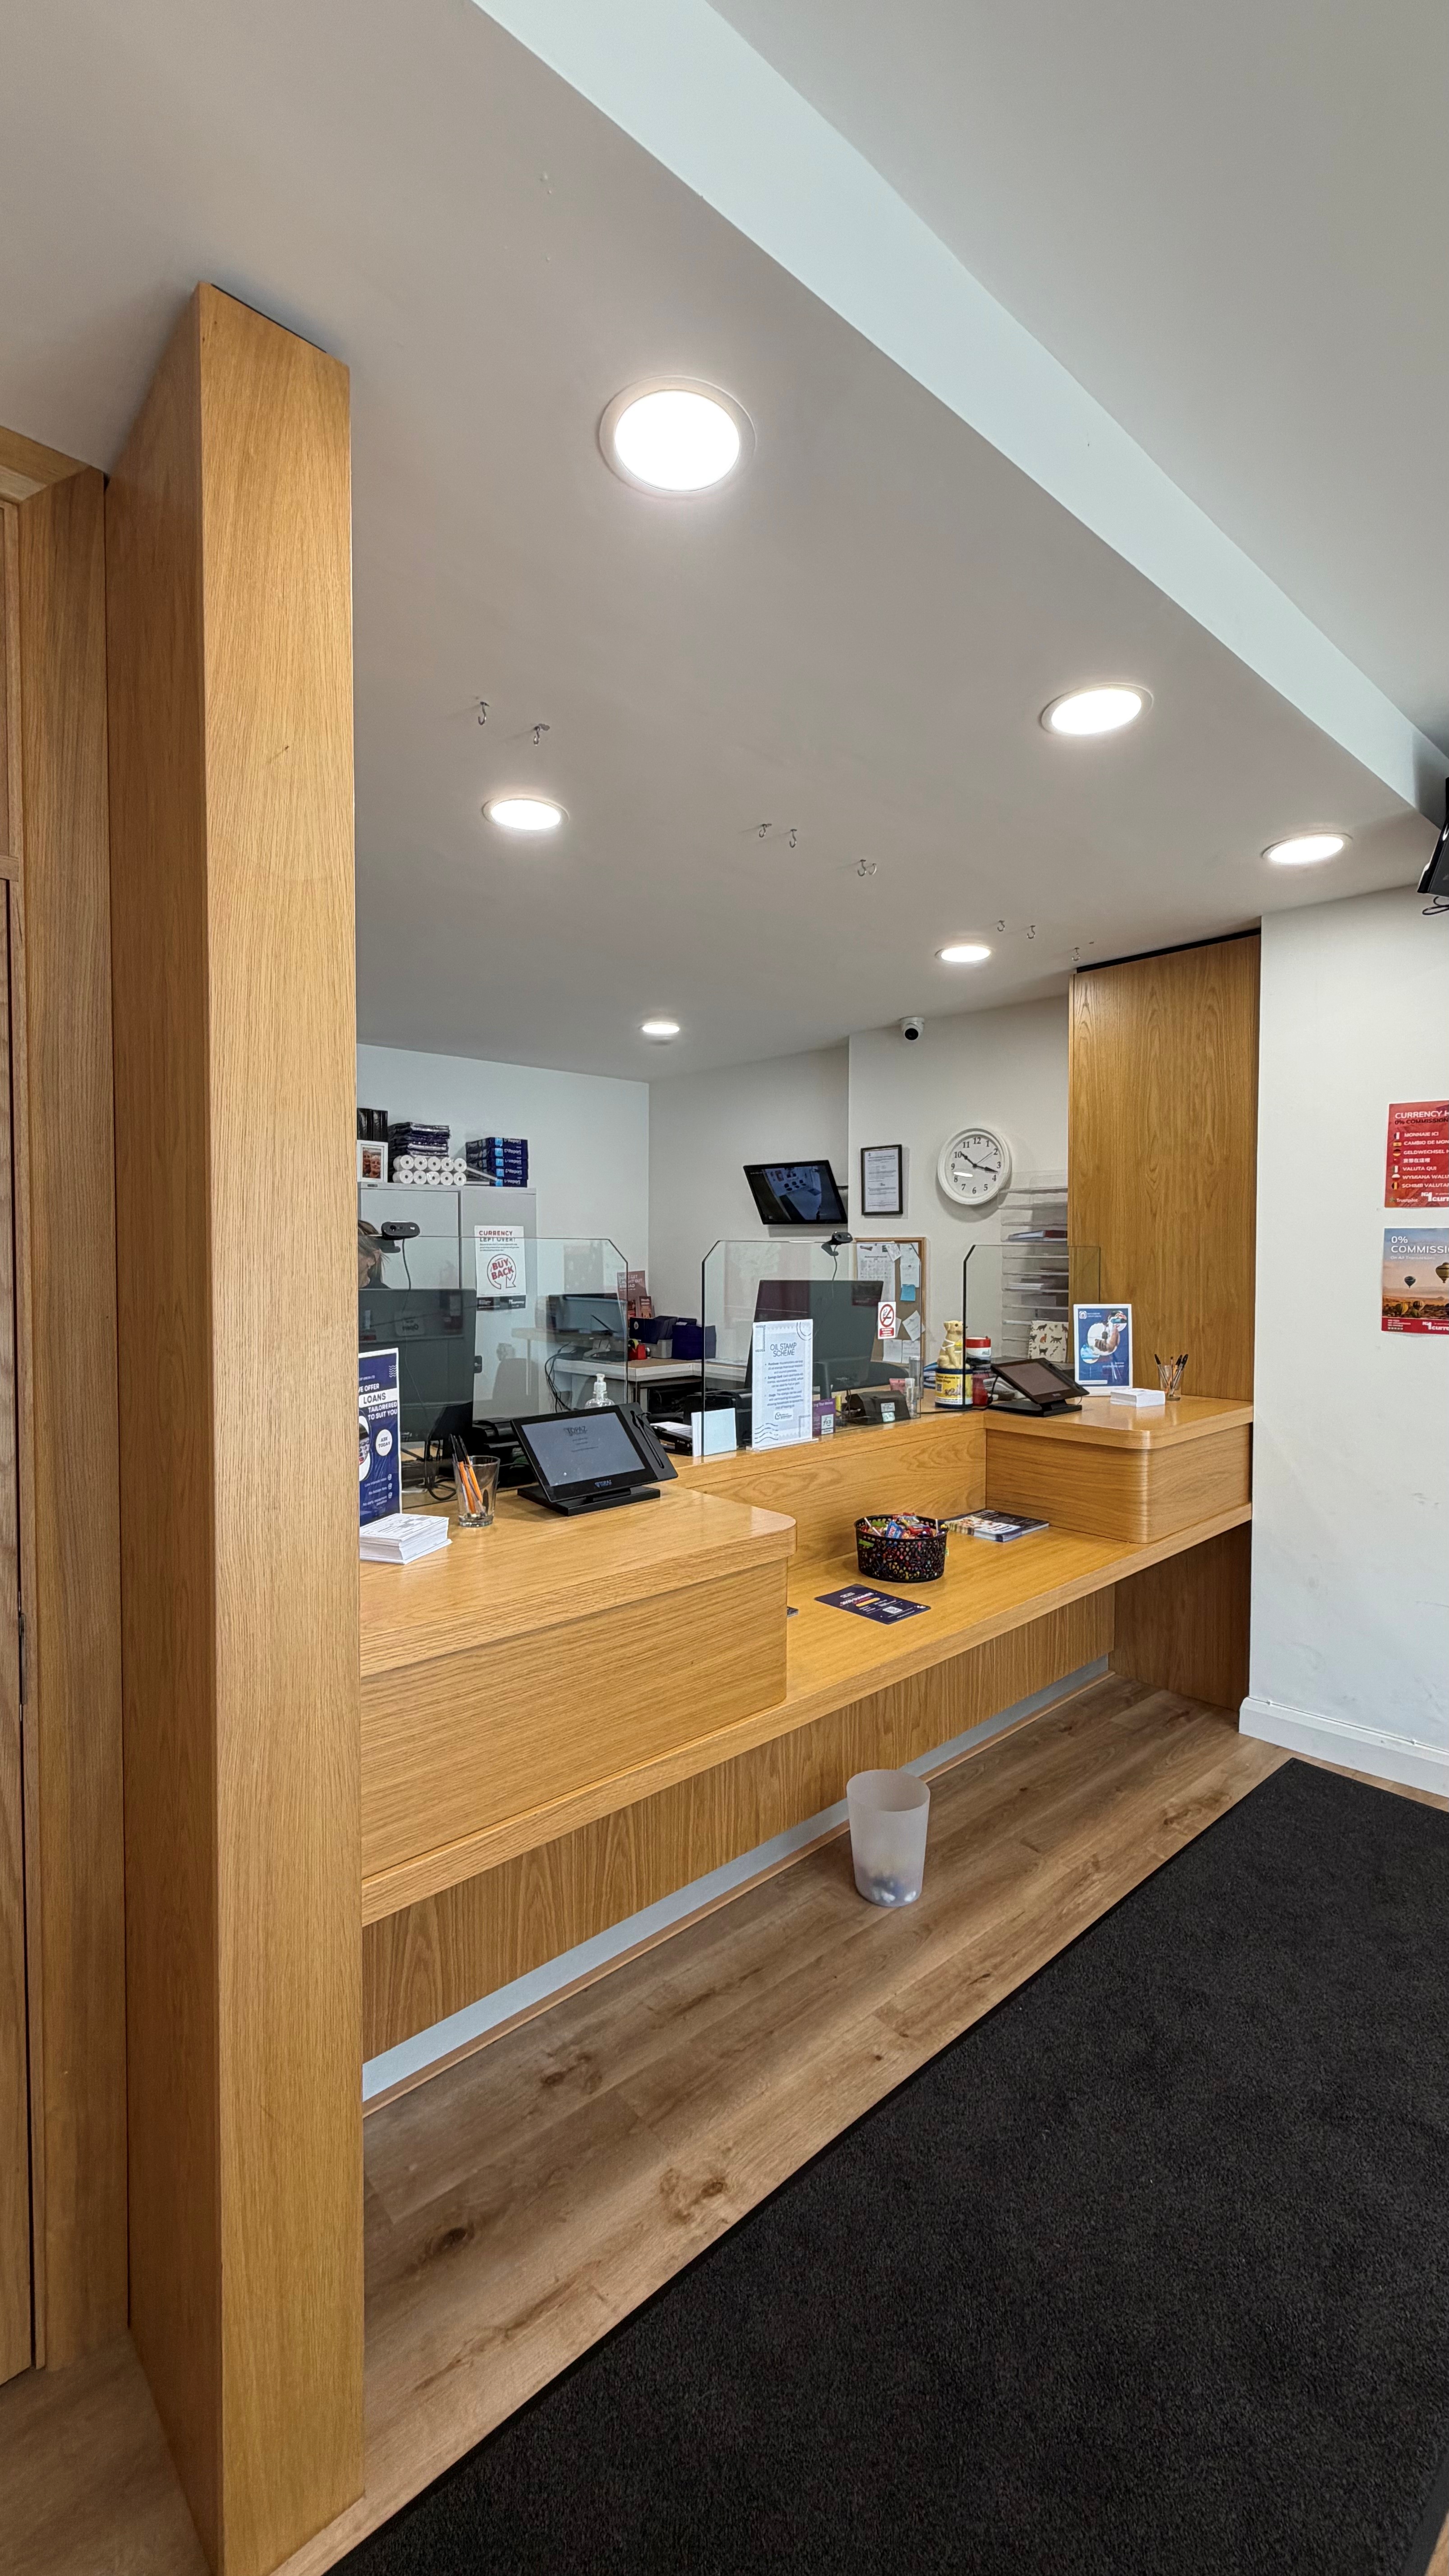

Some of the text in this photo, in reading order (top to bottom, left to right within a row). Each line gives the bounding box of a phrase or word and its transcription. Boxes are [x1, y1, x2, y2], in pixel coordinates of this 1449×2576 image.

[1395, 1111, 1442, 1119] CURRENCY
[492, 1258, 509, 1271] BUY
[491, 1266, 514, 1281] BACK
[773, 1349, 795, 1357] SCHEME
[364, 1383, 380, 1392] OFFER
[363, 1392, 386, 1404] LOANS
[368, 1402, 397, 1413] TAILORERED
[375, 1411, 386, 1419] SUIT
